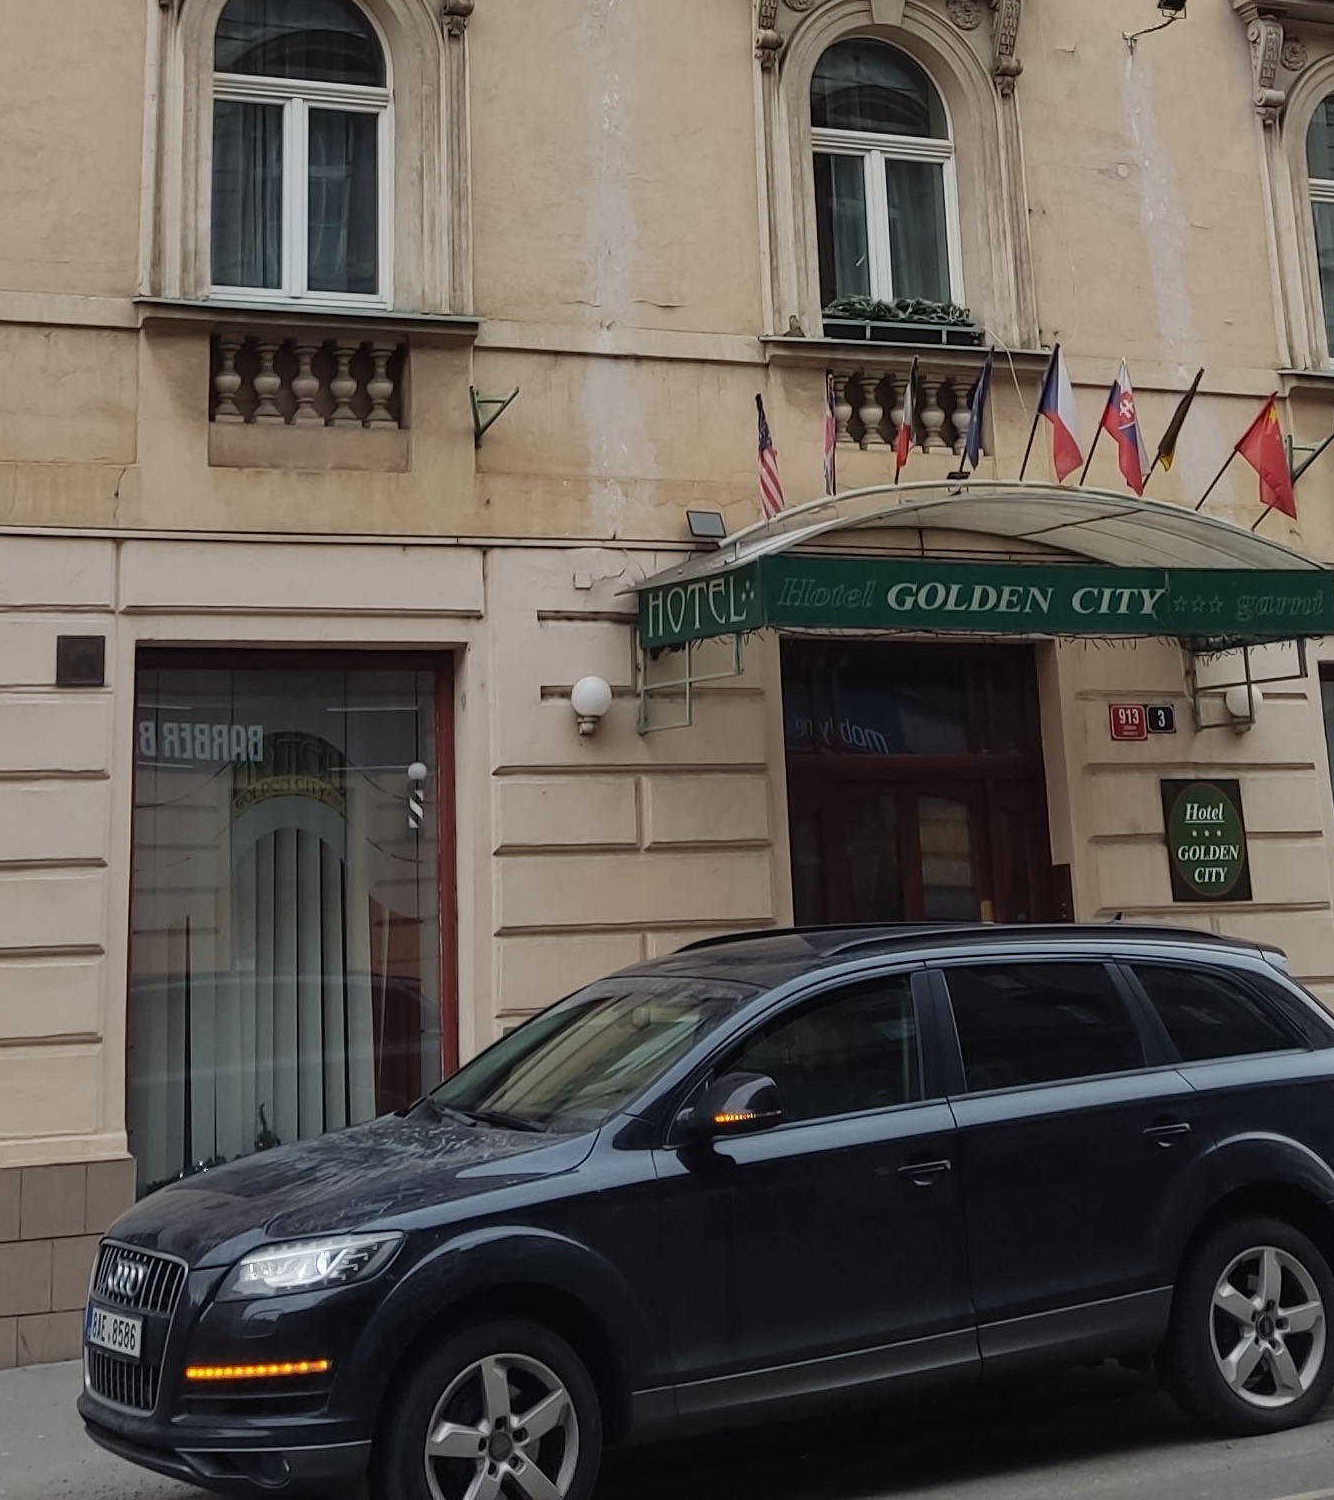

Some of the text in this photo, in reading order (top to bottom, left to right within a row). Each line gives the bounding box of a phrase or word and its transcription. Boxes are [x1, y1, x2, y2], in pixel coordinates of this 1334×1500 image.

[648, 576, 747, 638] HOTEL
[777, 577, 1324, 621] Hotel GOLDEN CITY garni
[1119, 708, 1139, 724] 913
[1157, 709, 1166, 727] 3
[1185, 802, 1224, 821] Hotel
[1178, 845, 1239, 861] GOLDEN
[1194, 867, 1228, 883] CITY
[112, 1318, 137, 1351] 8586
